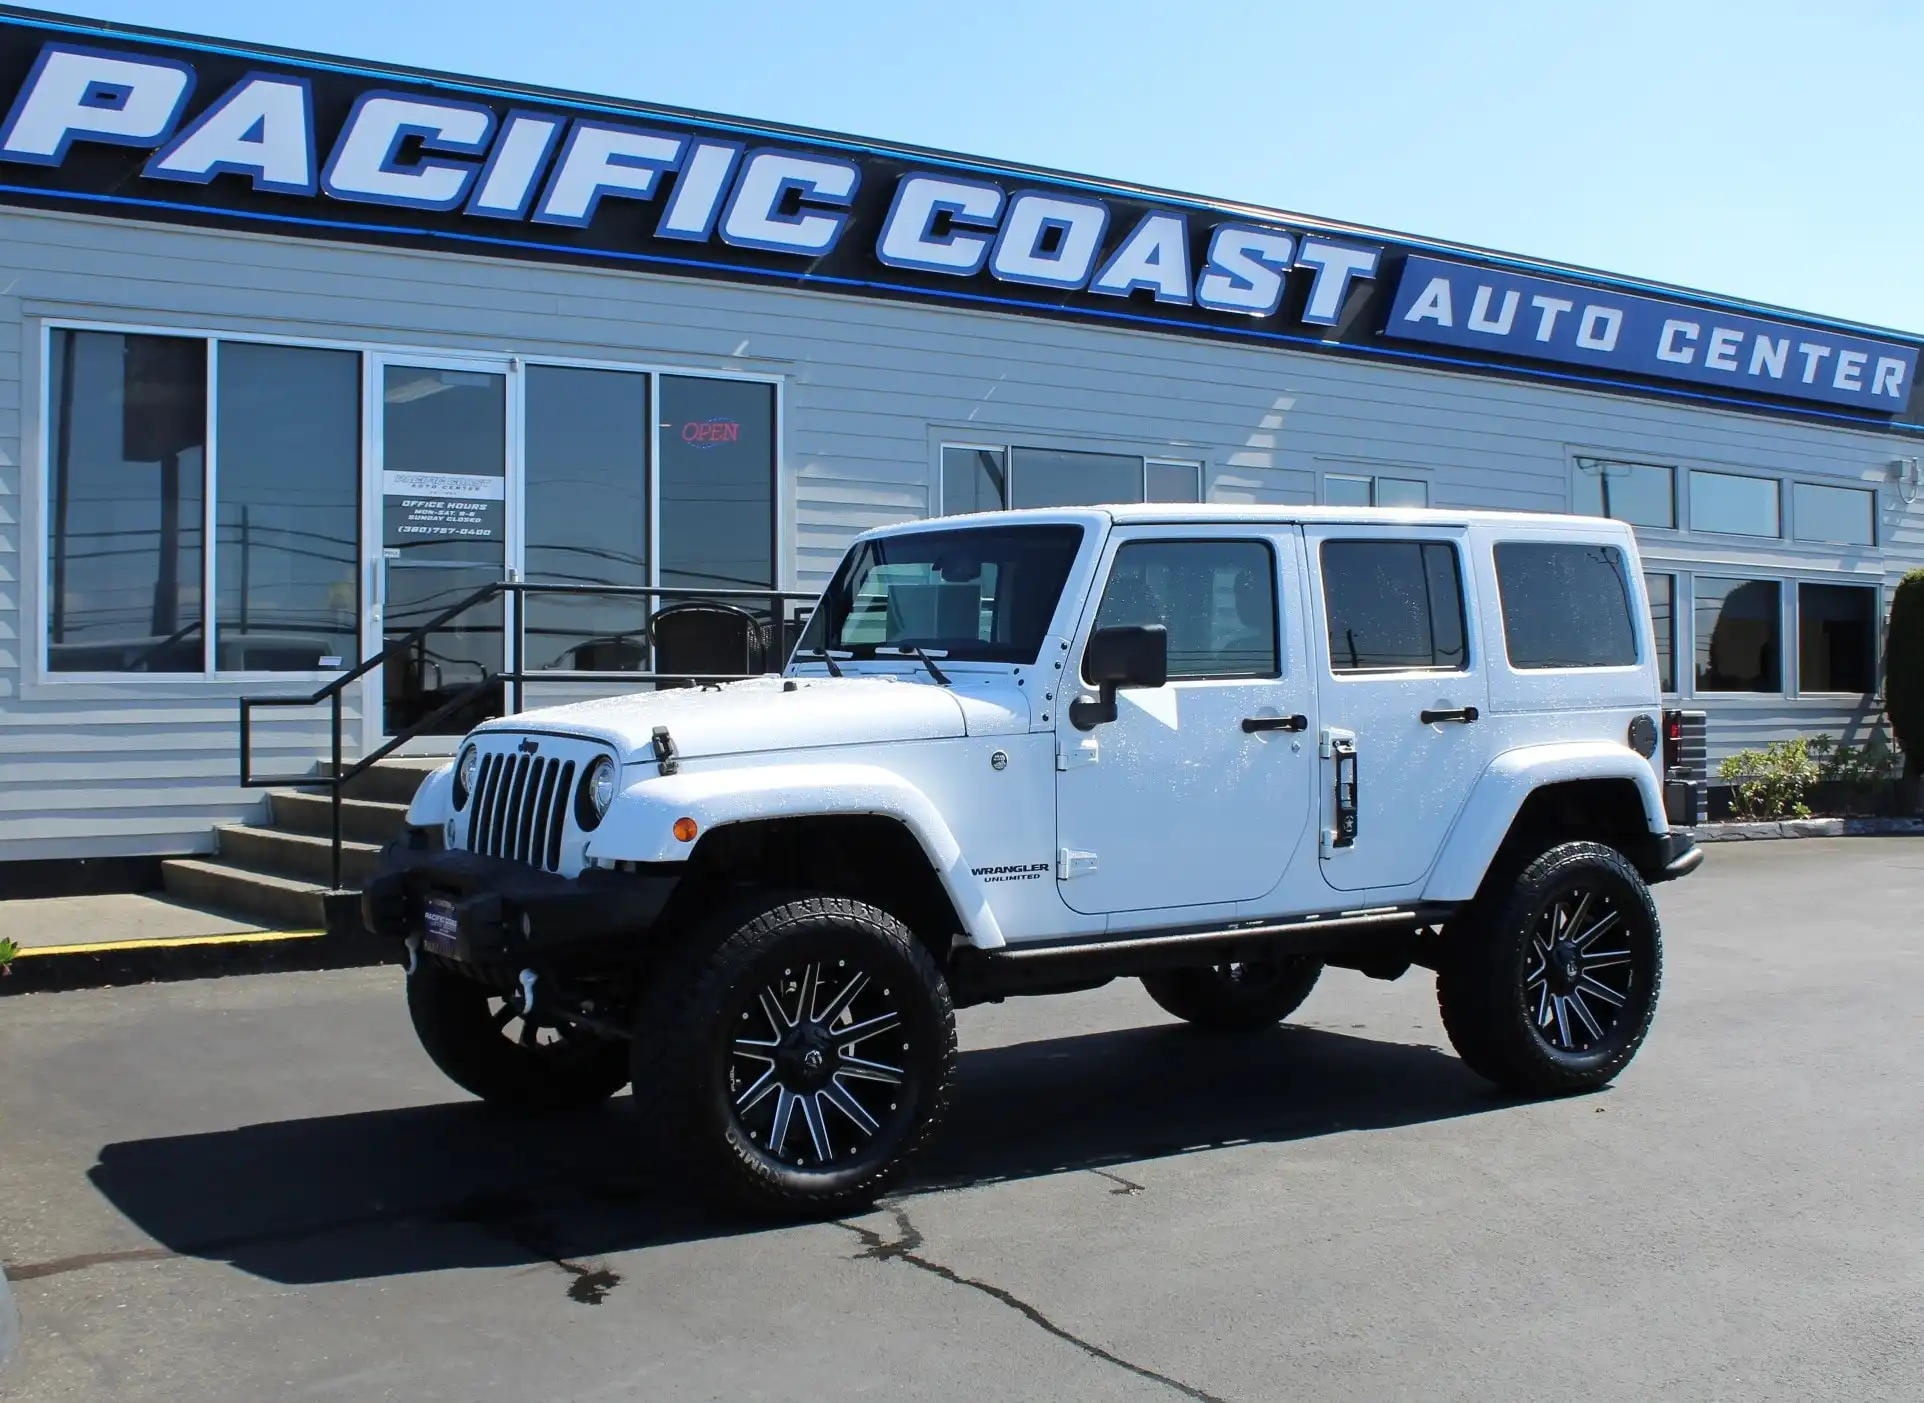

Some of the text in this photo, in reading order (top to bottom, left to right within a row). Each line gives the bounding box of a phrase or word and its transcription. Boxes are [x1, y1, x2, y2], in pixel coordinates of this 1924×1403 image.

[1, 41, 1383, 326] PACIFIC COAST
[1404, 276, 1907, 399] AUTO CENTER
[682, 422, 740, 441] OPEN
[402, 500, 488, 511] OFFICE HOURS
[408, 514, 445, 522] SUNDAY
[971, 863, 1050, 876] WRANGLER
[984, 874, 1041, 883] UNLIMITED
